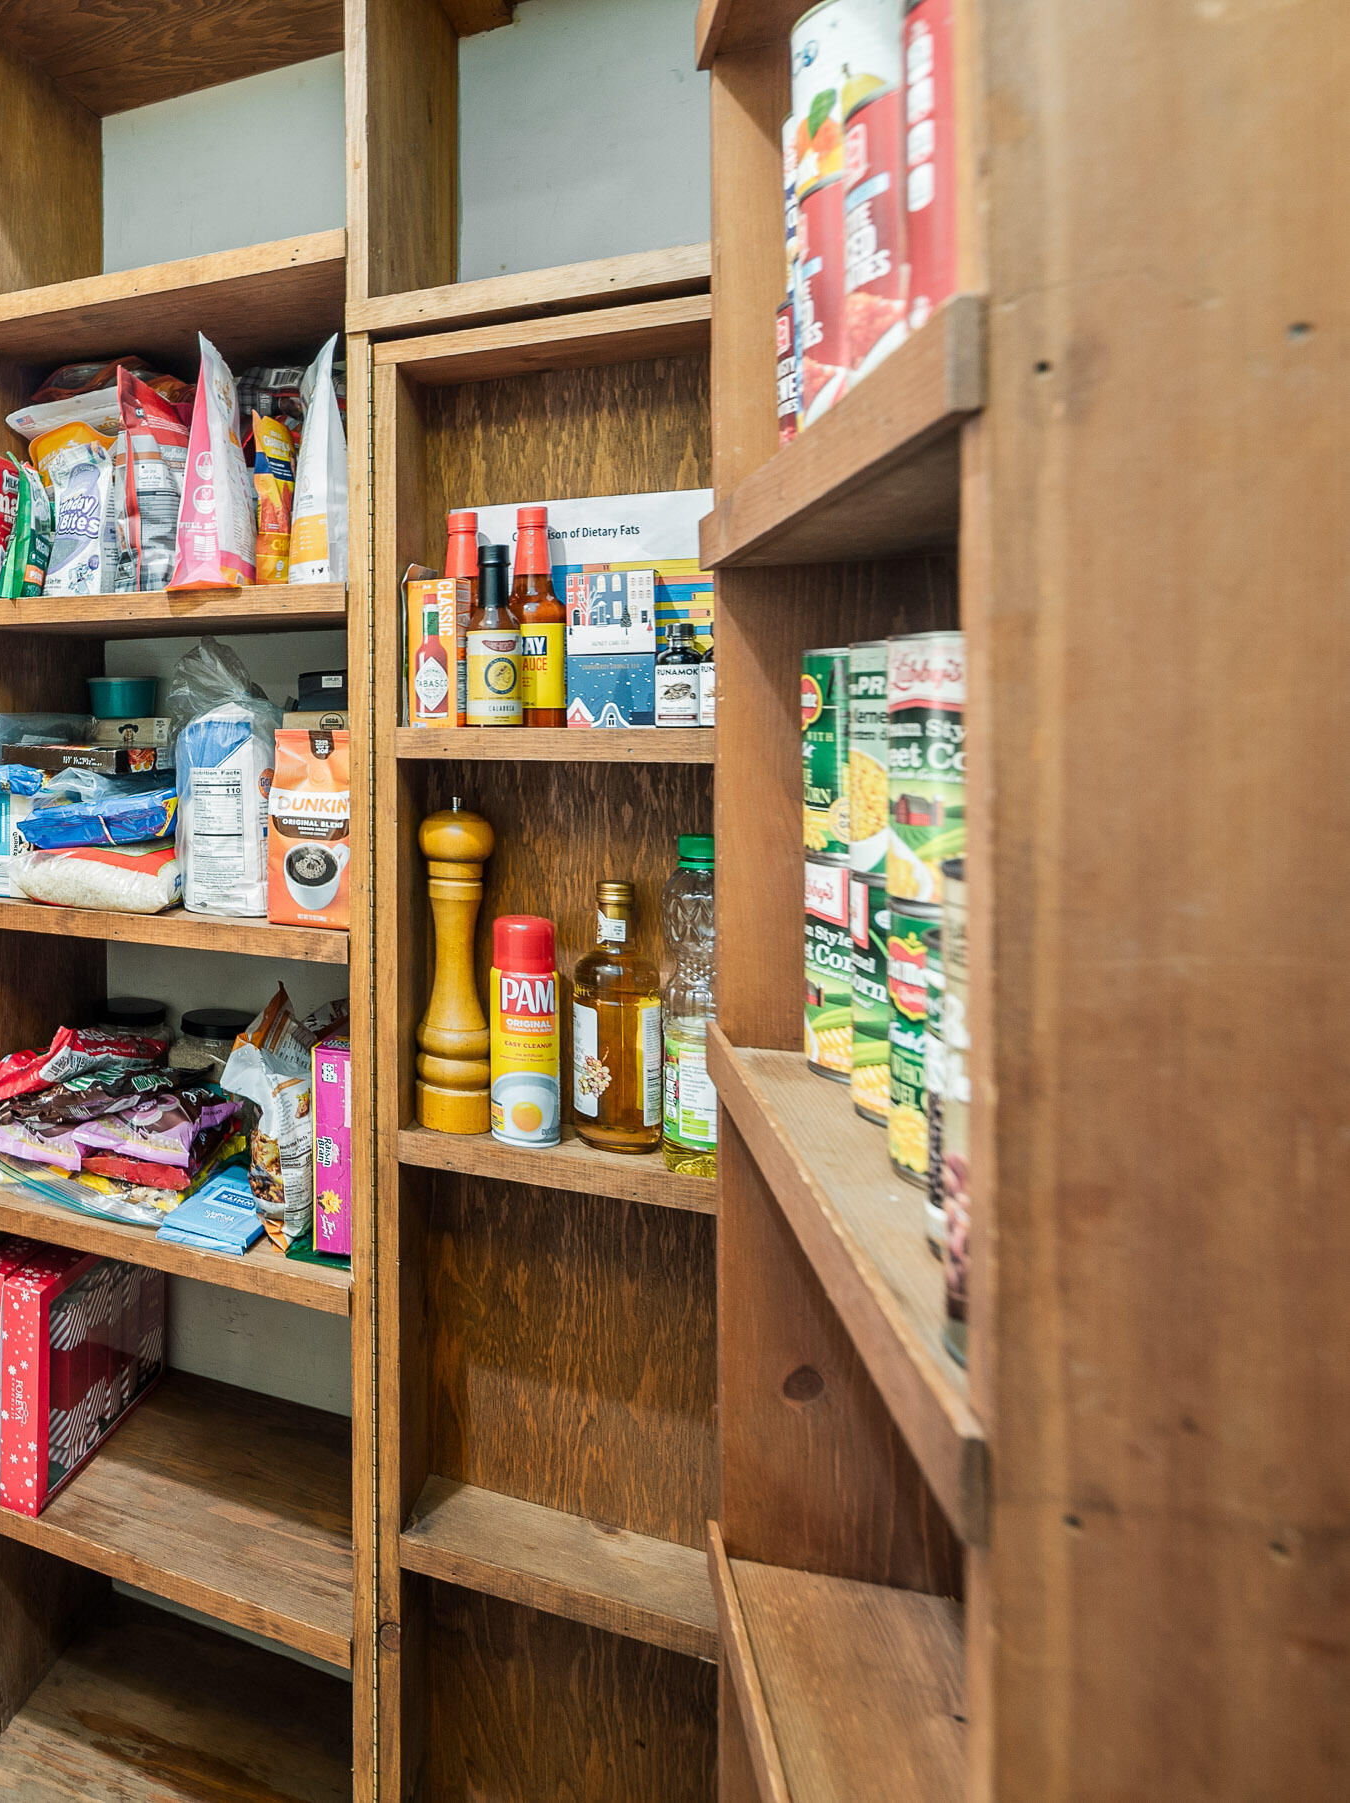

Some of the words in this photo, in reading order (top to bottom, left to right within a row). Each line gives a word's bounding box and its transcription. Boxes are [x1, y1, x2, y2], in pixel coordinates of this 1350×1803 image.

[570, 528, 579, 537] of
[582, 526, 618, 539] Dietary
[620, 524, 640, 536] Fats
[437, 580, 453, 636] CLASSIC
[522, 657, 547, 671] AUCE
[657, 668, 698, 676] RUNAMOK
[282, 818, 319, 827] ORIGINAL
[320, 820, 343, 828] BLEND
[815, 925, 854, 949] Style
[815, 944, 853, 973] Cor
[501, 977, 554, 1014] PAM
[506, 1018, 551, 1028] ORIGINAL
[504, 1040, 521, 1048] EASY
[324, 1137, 333, 1166] Raisin
